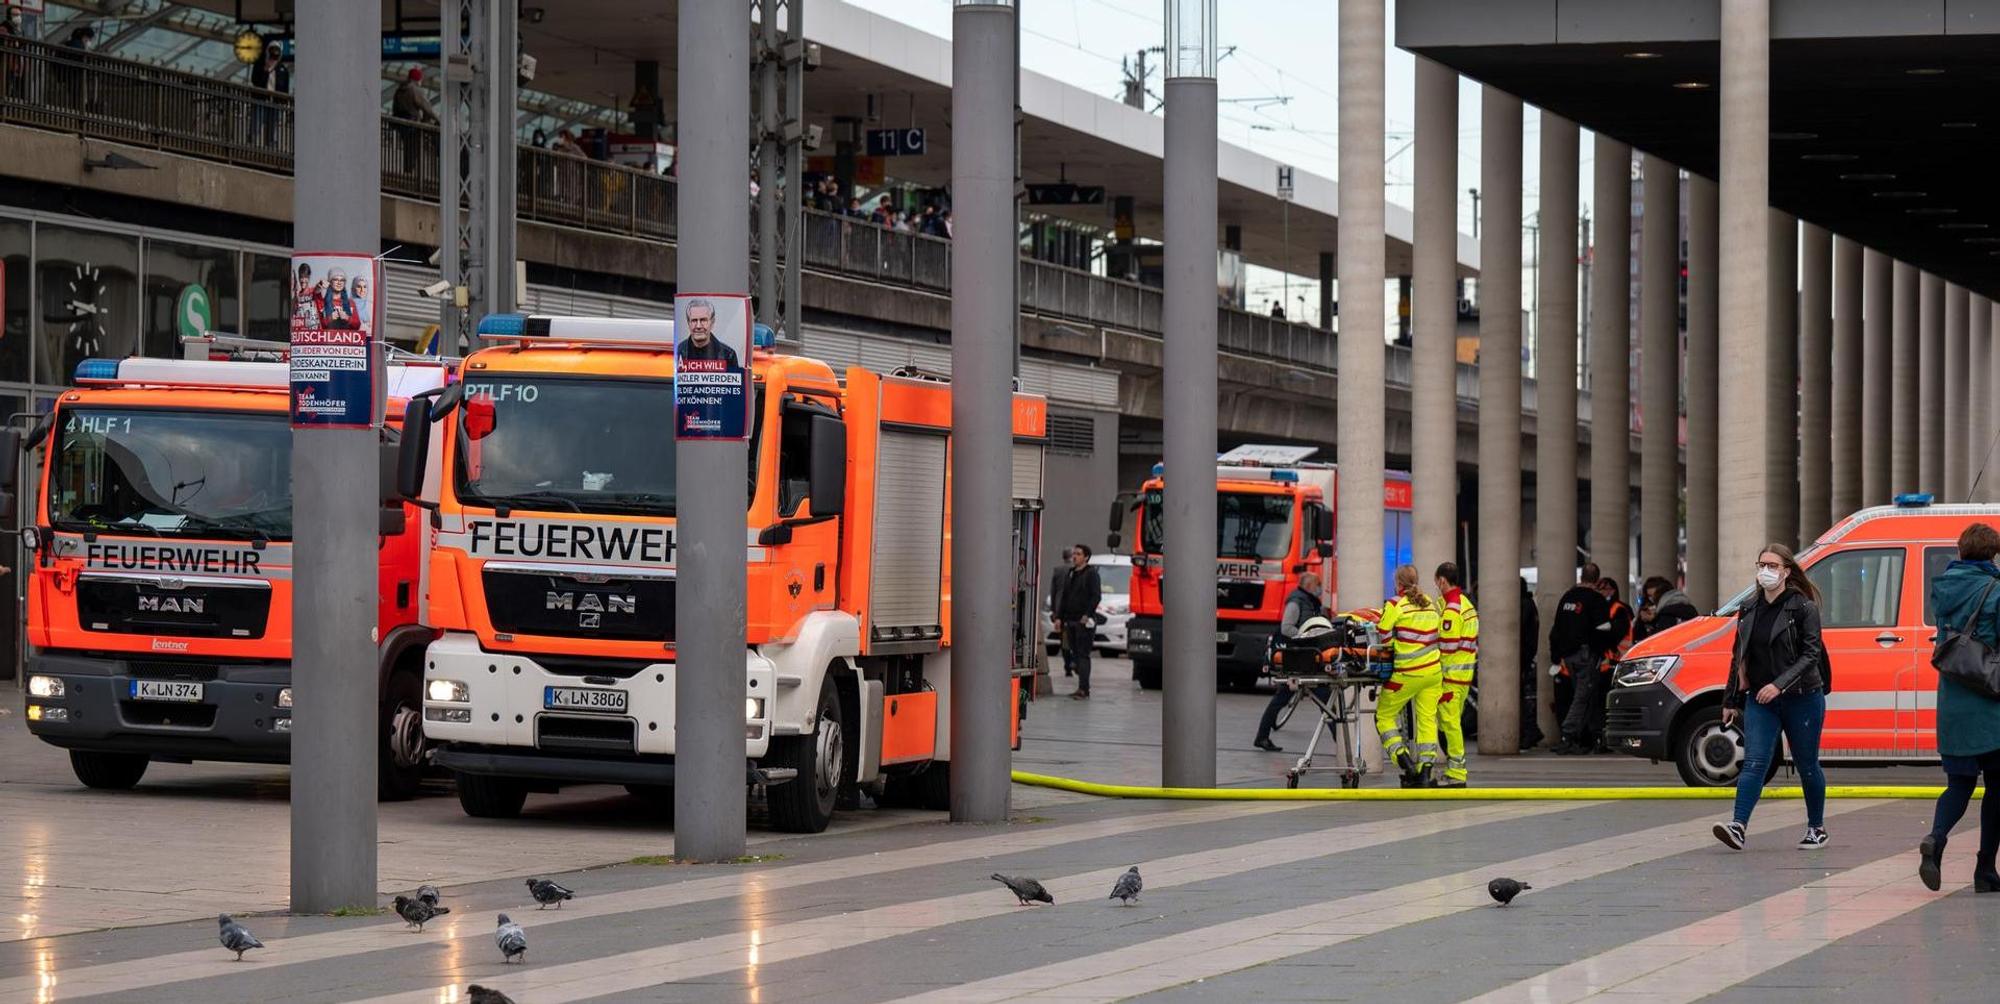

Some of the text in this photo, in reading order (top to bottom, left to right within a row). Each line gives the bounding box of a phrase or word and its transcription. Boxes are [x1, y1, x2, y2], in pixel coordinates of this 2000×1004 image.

[878, 128, 922, 150] 11 C
[1279, 167, 1292, 187] H
[187, 292, 205, 336] S
[324, 347, 341, 355] VON
[343, 347, 364, 355] EUCH
[687, 361, 703, 370] ICH
[703, 361, 725, 370] WILL
[693, 387, 732, 395] ANDEREN
[732, 387, 741, 395] ES
[65, 416, 132, 434] 4 HLF 1
[87, 544, 261, 575] FEUERWEHR
[138, 596, 204, 614] MAN
[545, 591, 636, 614] MAN
[141, 682, 198, 698] K LN 374
[553, 690, 624, 708] K LN 3806
